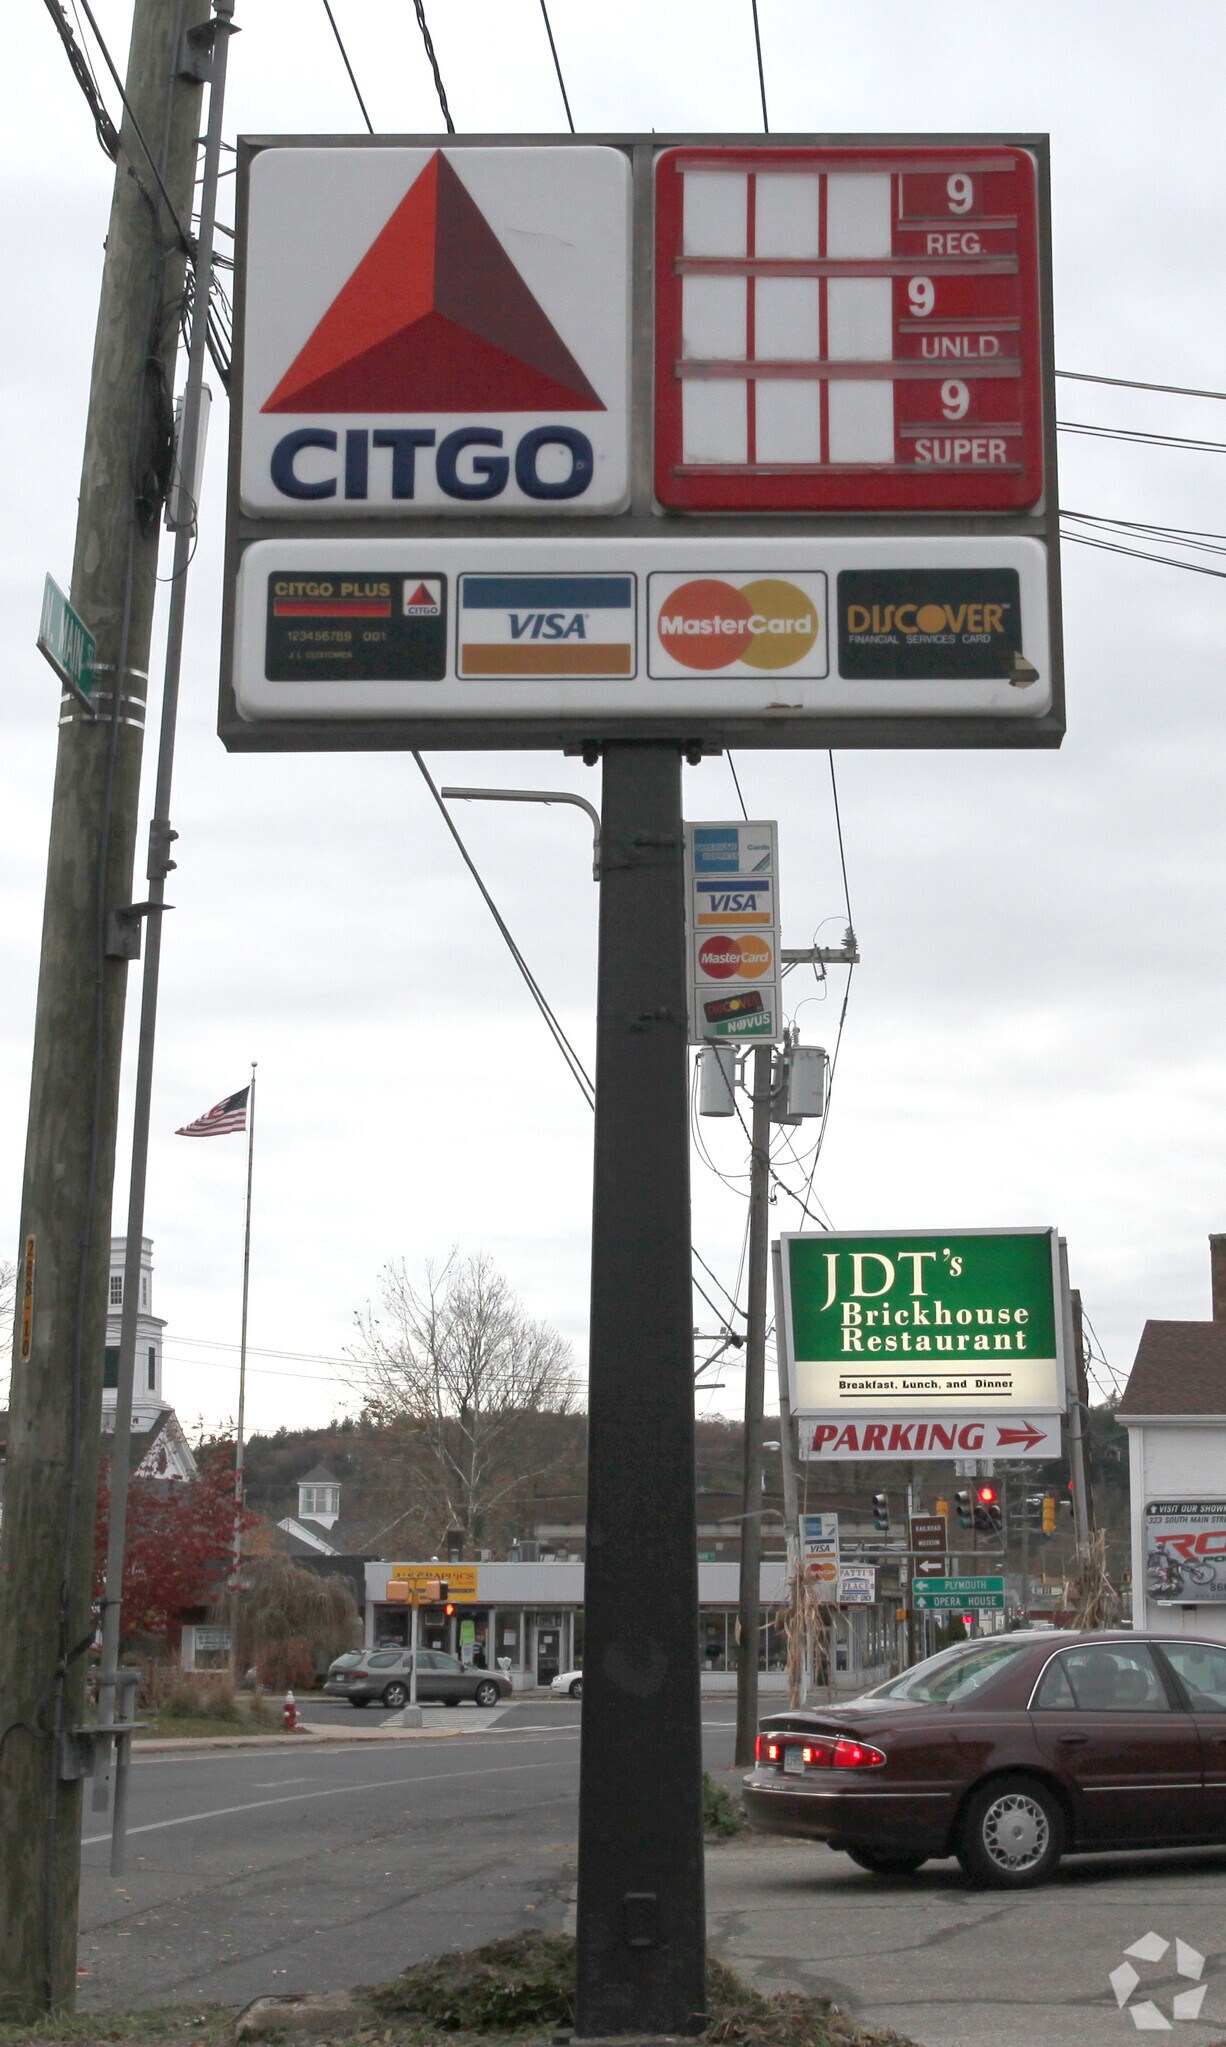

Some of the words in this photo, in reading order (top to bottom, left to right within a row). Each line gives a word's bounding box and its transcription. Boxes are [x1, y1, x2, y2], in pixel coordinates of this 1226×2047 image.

[946, 173, 974, 214] 9
[926, 233, 987, 255] REG.
[907, 276, 935, 317] 9
[940, 379, 970, 420] 9
[914, 438, 1006, 465] SUPER
[270, 425, 594, 501] CITGO
[274, 581, 333, 597] CITGO
[340, 582, 391, 597] PLUS
[408, 606, 438, 615] CITGO
[847, 603, 1005, 634] DISCOVER
[508, 613, 587, 640] VISA
[659, 613, 812, 636] MasterCard
[58, 605, 84, 680] MAIN
[288, 631, 352, 642] 123456789
[362, 631, 386, 642] 001
[848, 634, 899, 645] FINANCIAL
[906, 634, 956, 645] SERVICES
[962, 634, 991, 644] CARD
[709, 894, 757, 912] VISA
[701, 952, 769, 964] MasterCard
[727, 1013, 770, 1033] NOVUS
[820, 1248, 963, 1311] JDT's
[840, 1301, 1029, 1326] Brickhouse
[840, 1327, 1027, 1352] Restaurant
[838, 1380, 899, 1391] Breakfast,
[902, 1380, 942, 1390] Lunch,
[946, 1380, 968, 1389] and
[975, 1379, 1014, 1389] Dinner
[810, 1423, 985, 1452] PARKING
[1148, 1516, 1162, 1524] 323
[1165, 1516, 1188, 1524] SOUTH
[1190, 1516, 1209, 1524] MAIN
[1159, 1505, 1178, 1513] VISIT
[1181, 1505, 1197, 1513] OUR
[810, 1545, 830, 1553] VISA
[944, 1581, 987, 1590] PLYMOUTH
[934, 1597, 961, 1606] OPERA
[968, 1596, 997, 1606] HOUSE
